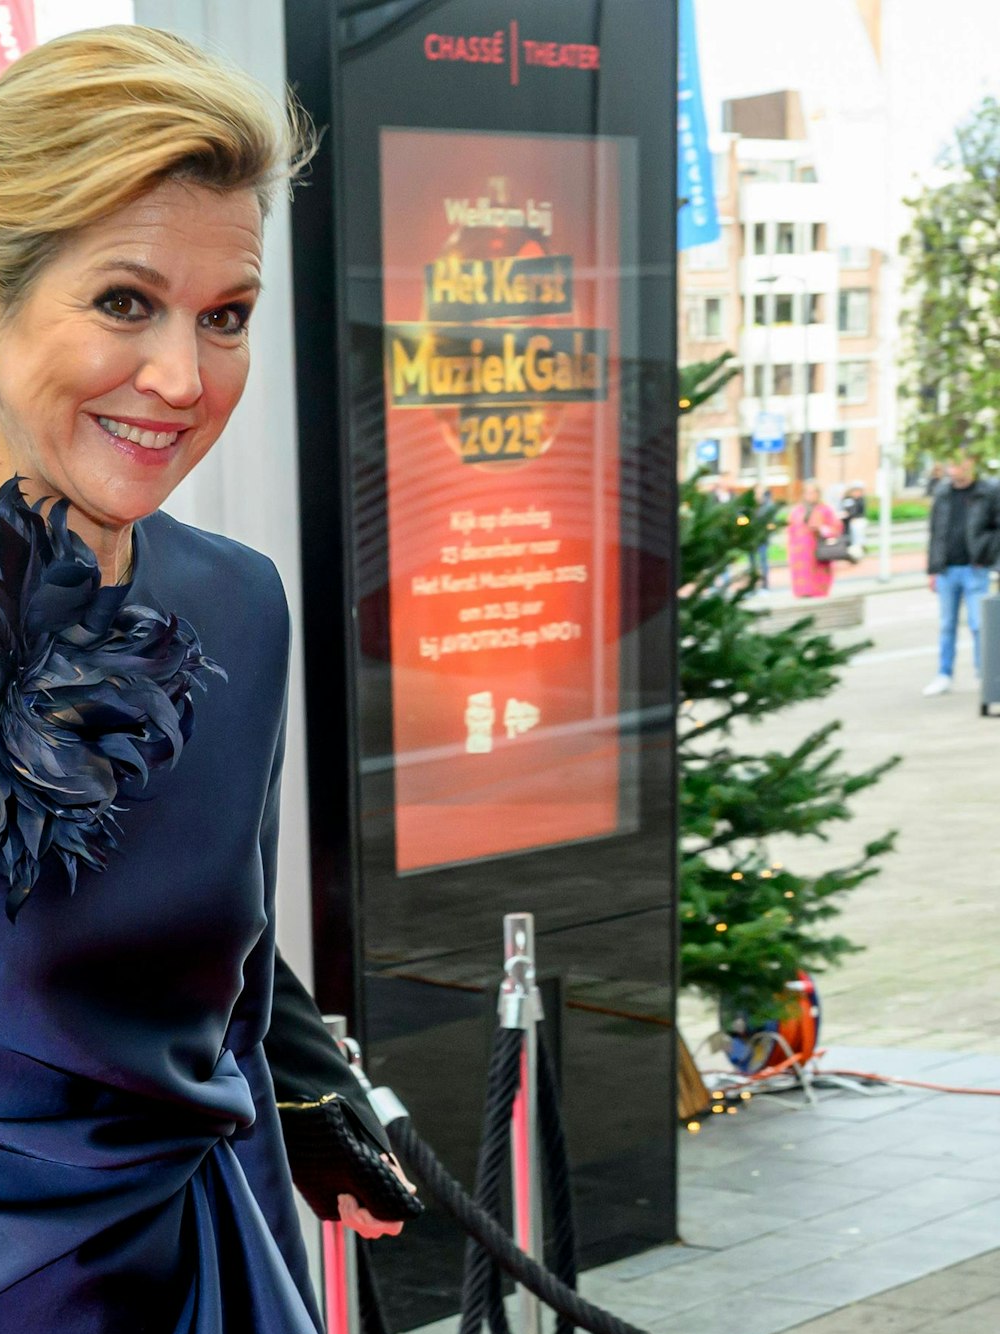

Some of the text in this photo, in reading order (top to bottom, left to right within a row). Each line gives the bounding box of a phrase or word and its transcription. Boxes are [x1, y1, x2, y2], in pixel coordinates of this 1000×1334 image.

[424, 31, 600, 70] CHASSÉ THEATER
[444, 198, 552, 236] Welkom bij
[433, 256, 566, 304] Het Kerst
[392, 331, 601, 397] MuziekGala
[460, 411, 544, 458] 2025
